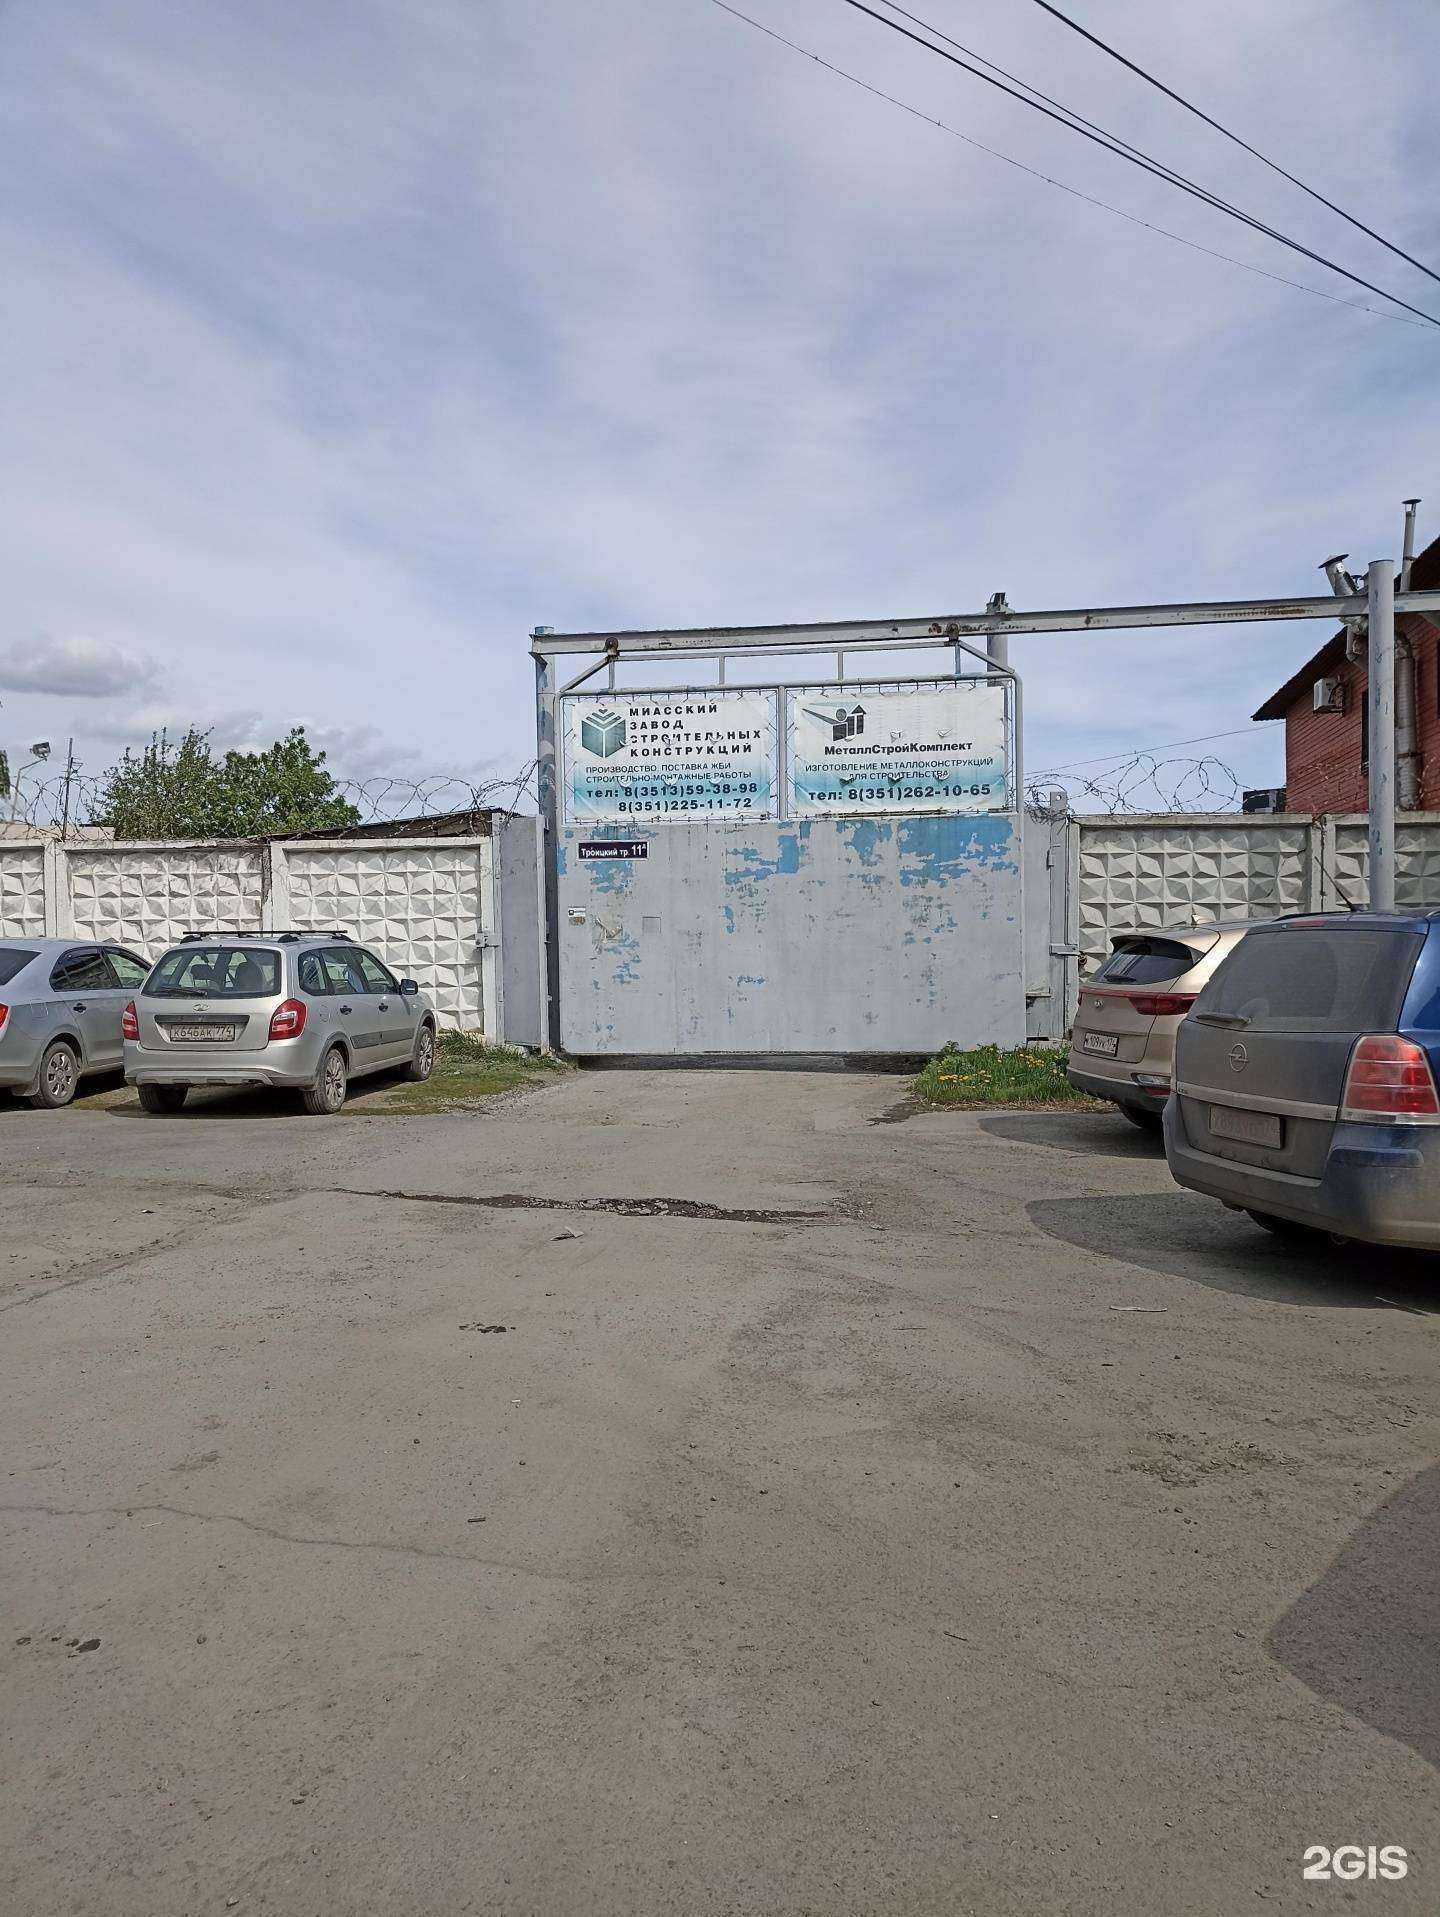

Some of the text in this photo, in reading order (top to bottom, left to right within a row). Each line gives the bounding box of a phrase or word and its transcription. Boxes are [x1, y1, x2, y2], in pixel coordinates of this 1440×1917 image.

[629, 702, 718, 716] МИАССКИЙ
[629, 719, 684, 730] ЗАВОД
[630, 744, 752, 757] КОНСТРУКЦИЙ
[824, 742, 973, 756] МеталлСтройКомплект
[586, 762, 731, 774] ПРОИЗВОДСТВО ПОСТАВКА ЖБИ
[805, 757, 994, 772] ИЗГОТОВЛЕНИЕ МЕТАЛЛОКОНСТРУКЦИЙ
[714, 771, 752, 780] РАБОТЫ
[586, 783, 758, 798] тел: 8(3513)59-38-98
[808, 783, 991, 802] тел: 8(351)262-10-65
[618, 797, 752, 813] 8(351)225-11-72
